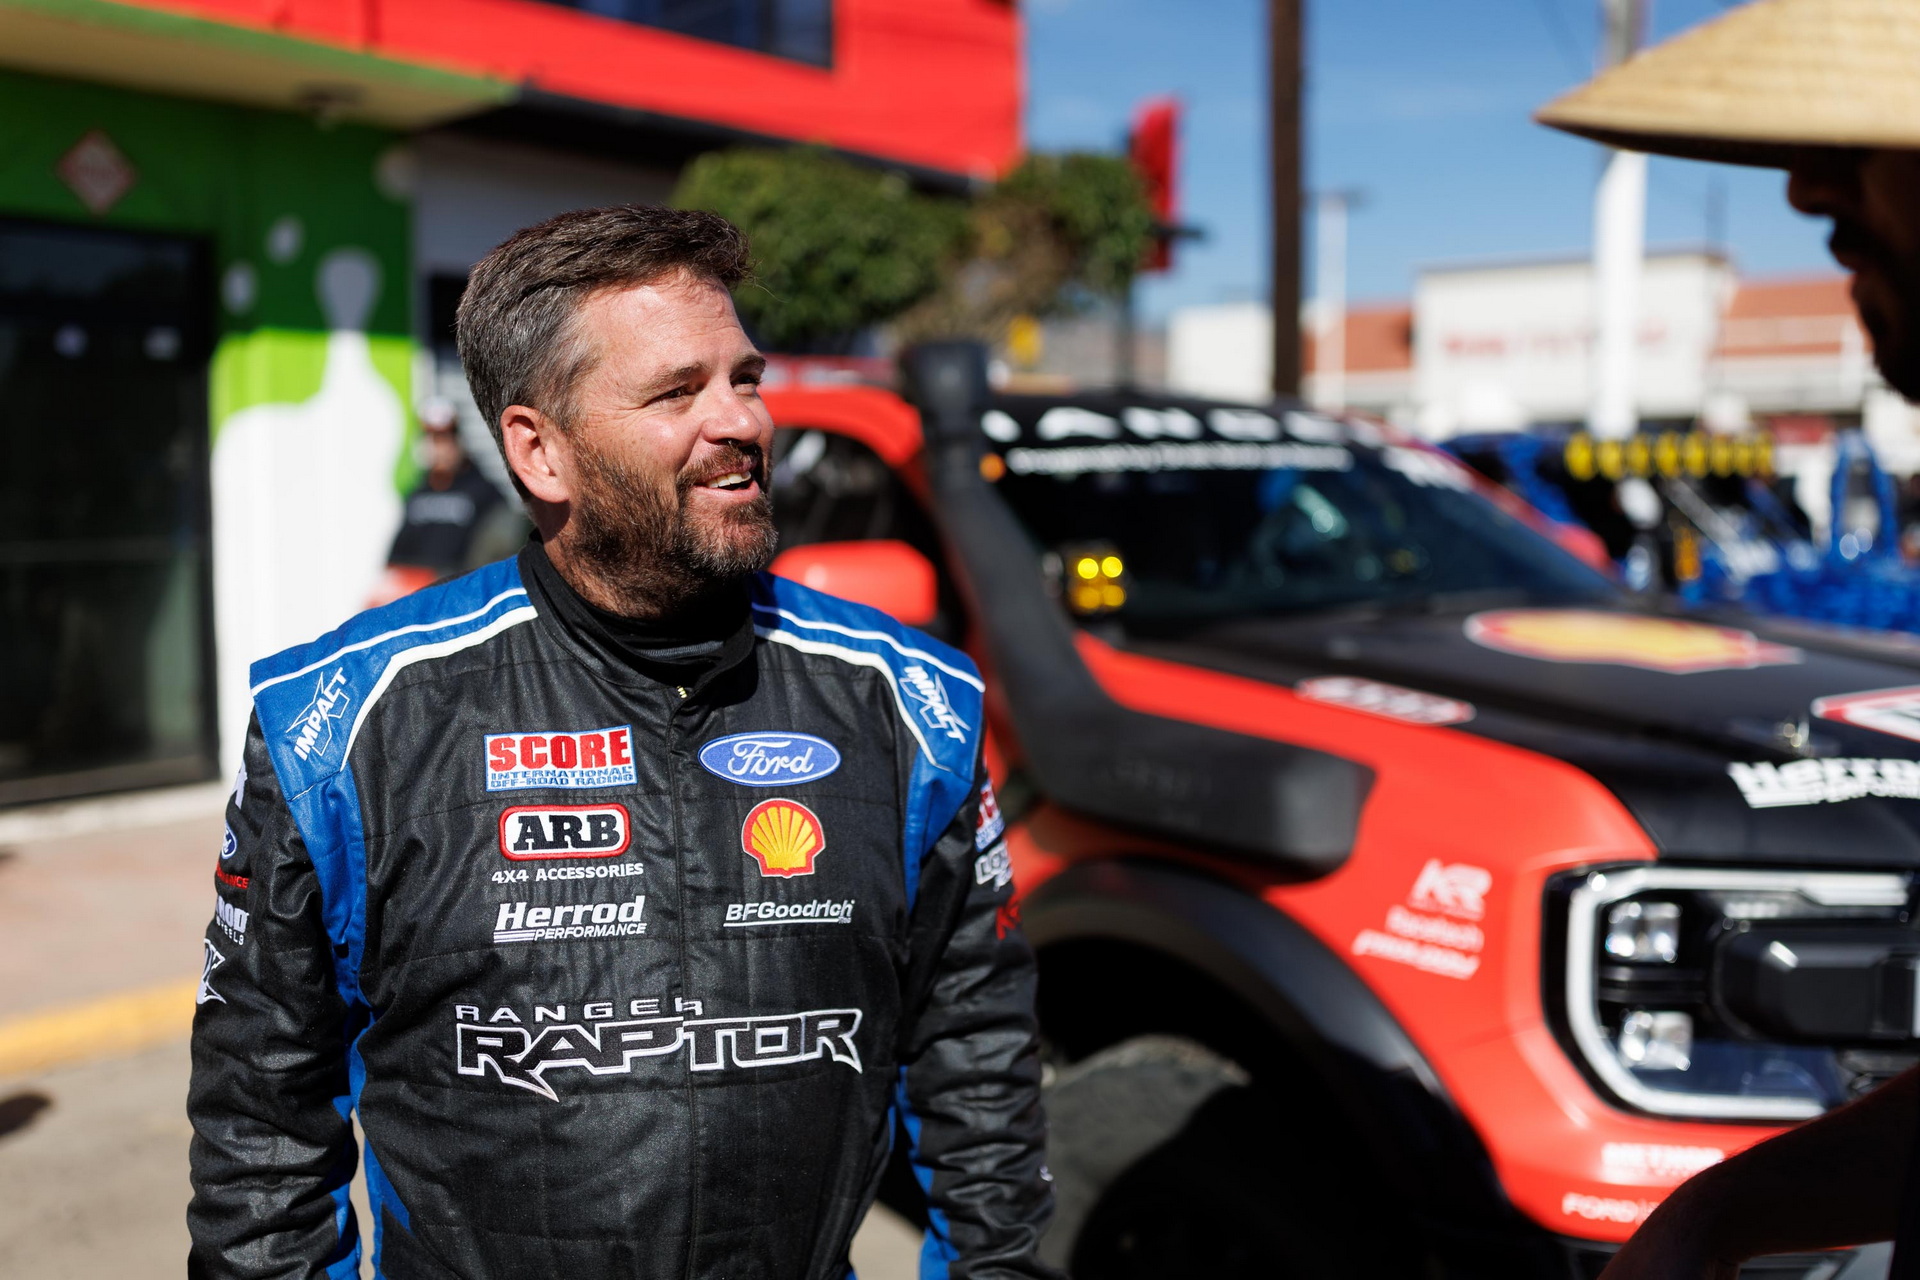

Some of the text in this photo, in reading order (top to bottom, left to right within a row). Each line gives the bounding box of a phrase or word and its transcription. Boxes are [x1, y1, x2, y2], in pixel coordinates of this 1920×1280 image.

[293, 666, 348, 761] IMPACT
[903, 665, 967, 744] IMPACT
[489, 729, 631, 772] SCORE
[728, 740, 814, 776] Ford
[490, 774, 633, 788] OFF-ROAD RACING
[491, 766, 632, 780] INTERNATIONAL
[512, 813, 621, 852] ARB
[491, 863, 644, 884] 4X4 ACCESSORIES
[494, 895, 646, 931] Herrod
[725, 899, 853, 921] BFGoodrich
[534, 922, 647, 941] PERFORMANCE
[455, 996, 703, 1023] RANGER
[457, 1008, 863, 1102] RAPTOR
